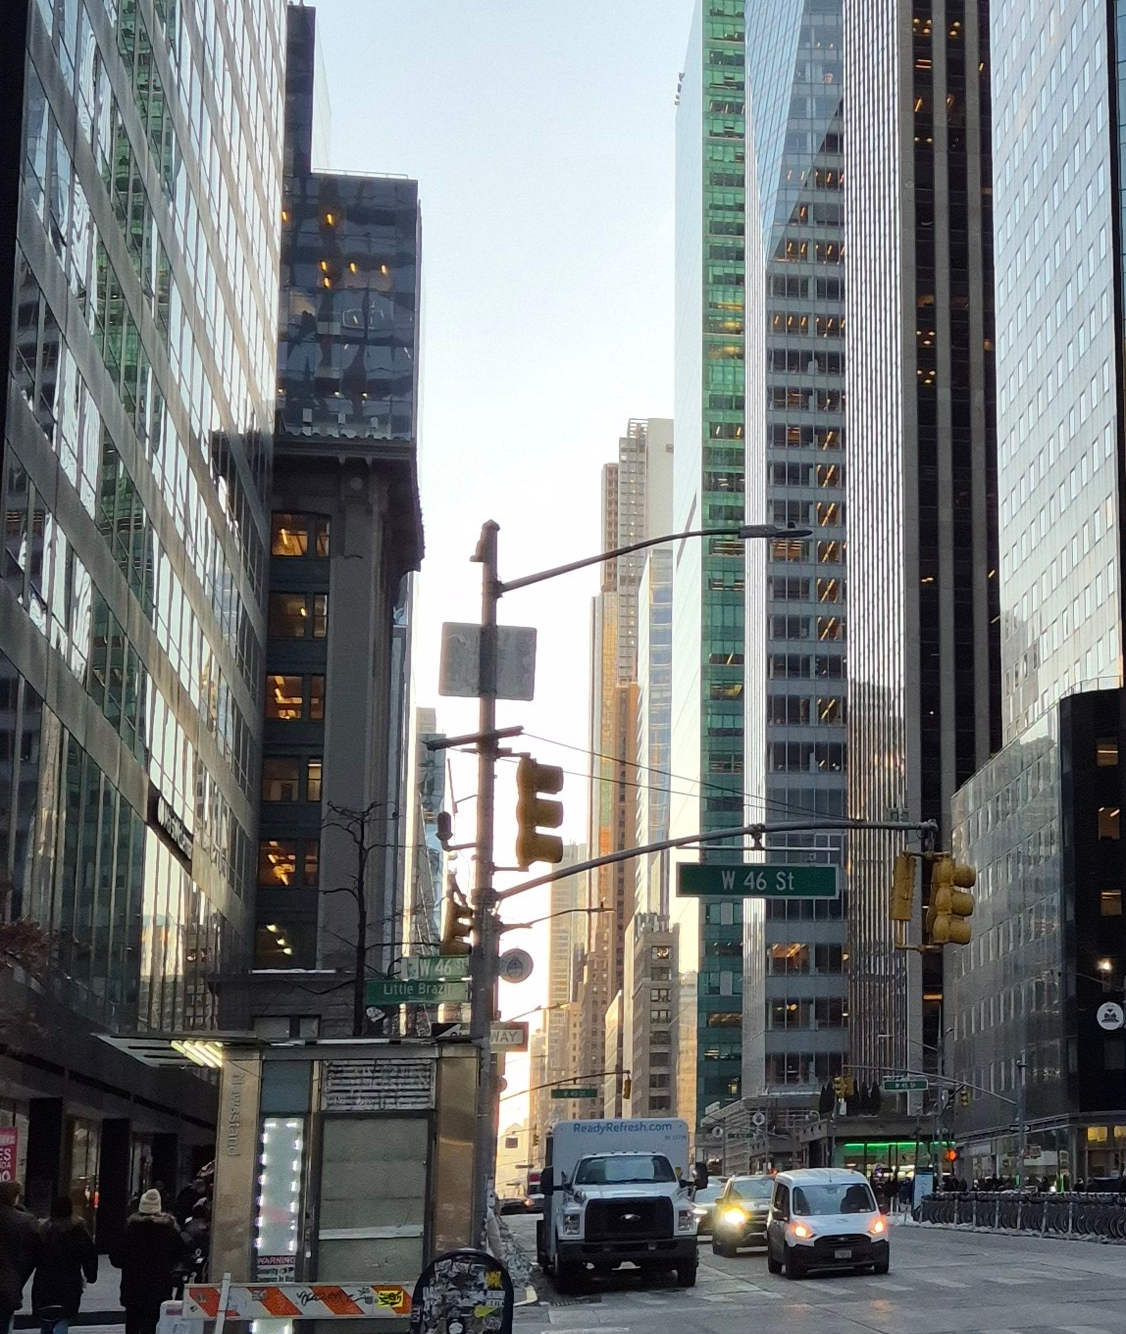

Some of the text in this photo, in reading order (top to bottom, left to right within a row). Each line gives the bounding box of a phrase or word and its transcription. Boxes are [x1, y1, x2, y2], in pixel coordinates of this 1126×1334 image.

[721, 870, 795, 891] W 46 St
[419, 959, 430, 976] W
[434, 959, 452, 976] 46
[383, 982, 450, 996] Little Brazil
[490, 1032, 518, 1043] WAY
[228, 1072, 246, 1157] Newsstand
[573, 1122, 672, 1135] ReadyRefresh.com
[257, 1256, 296, 1265] WARNING
